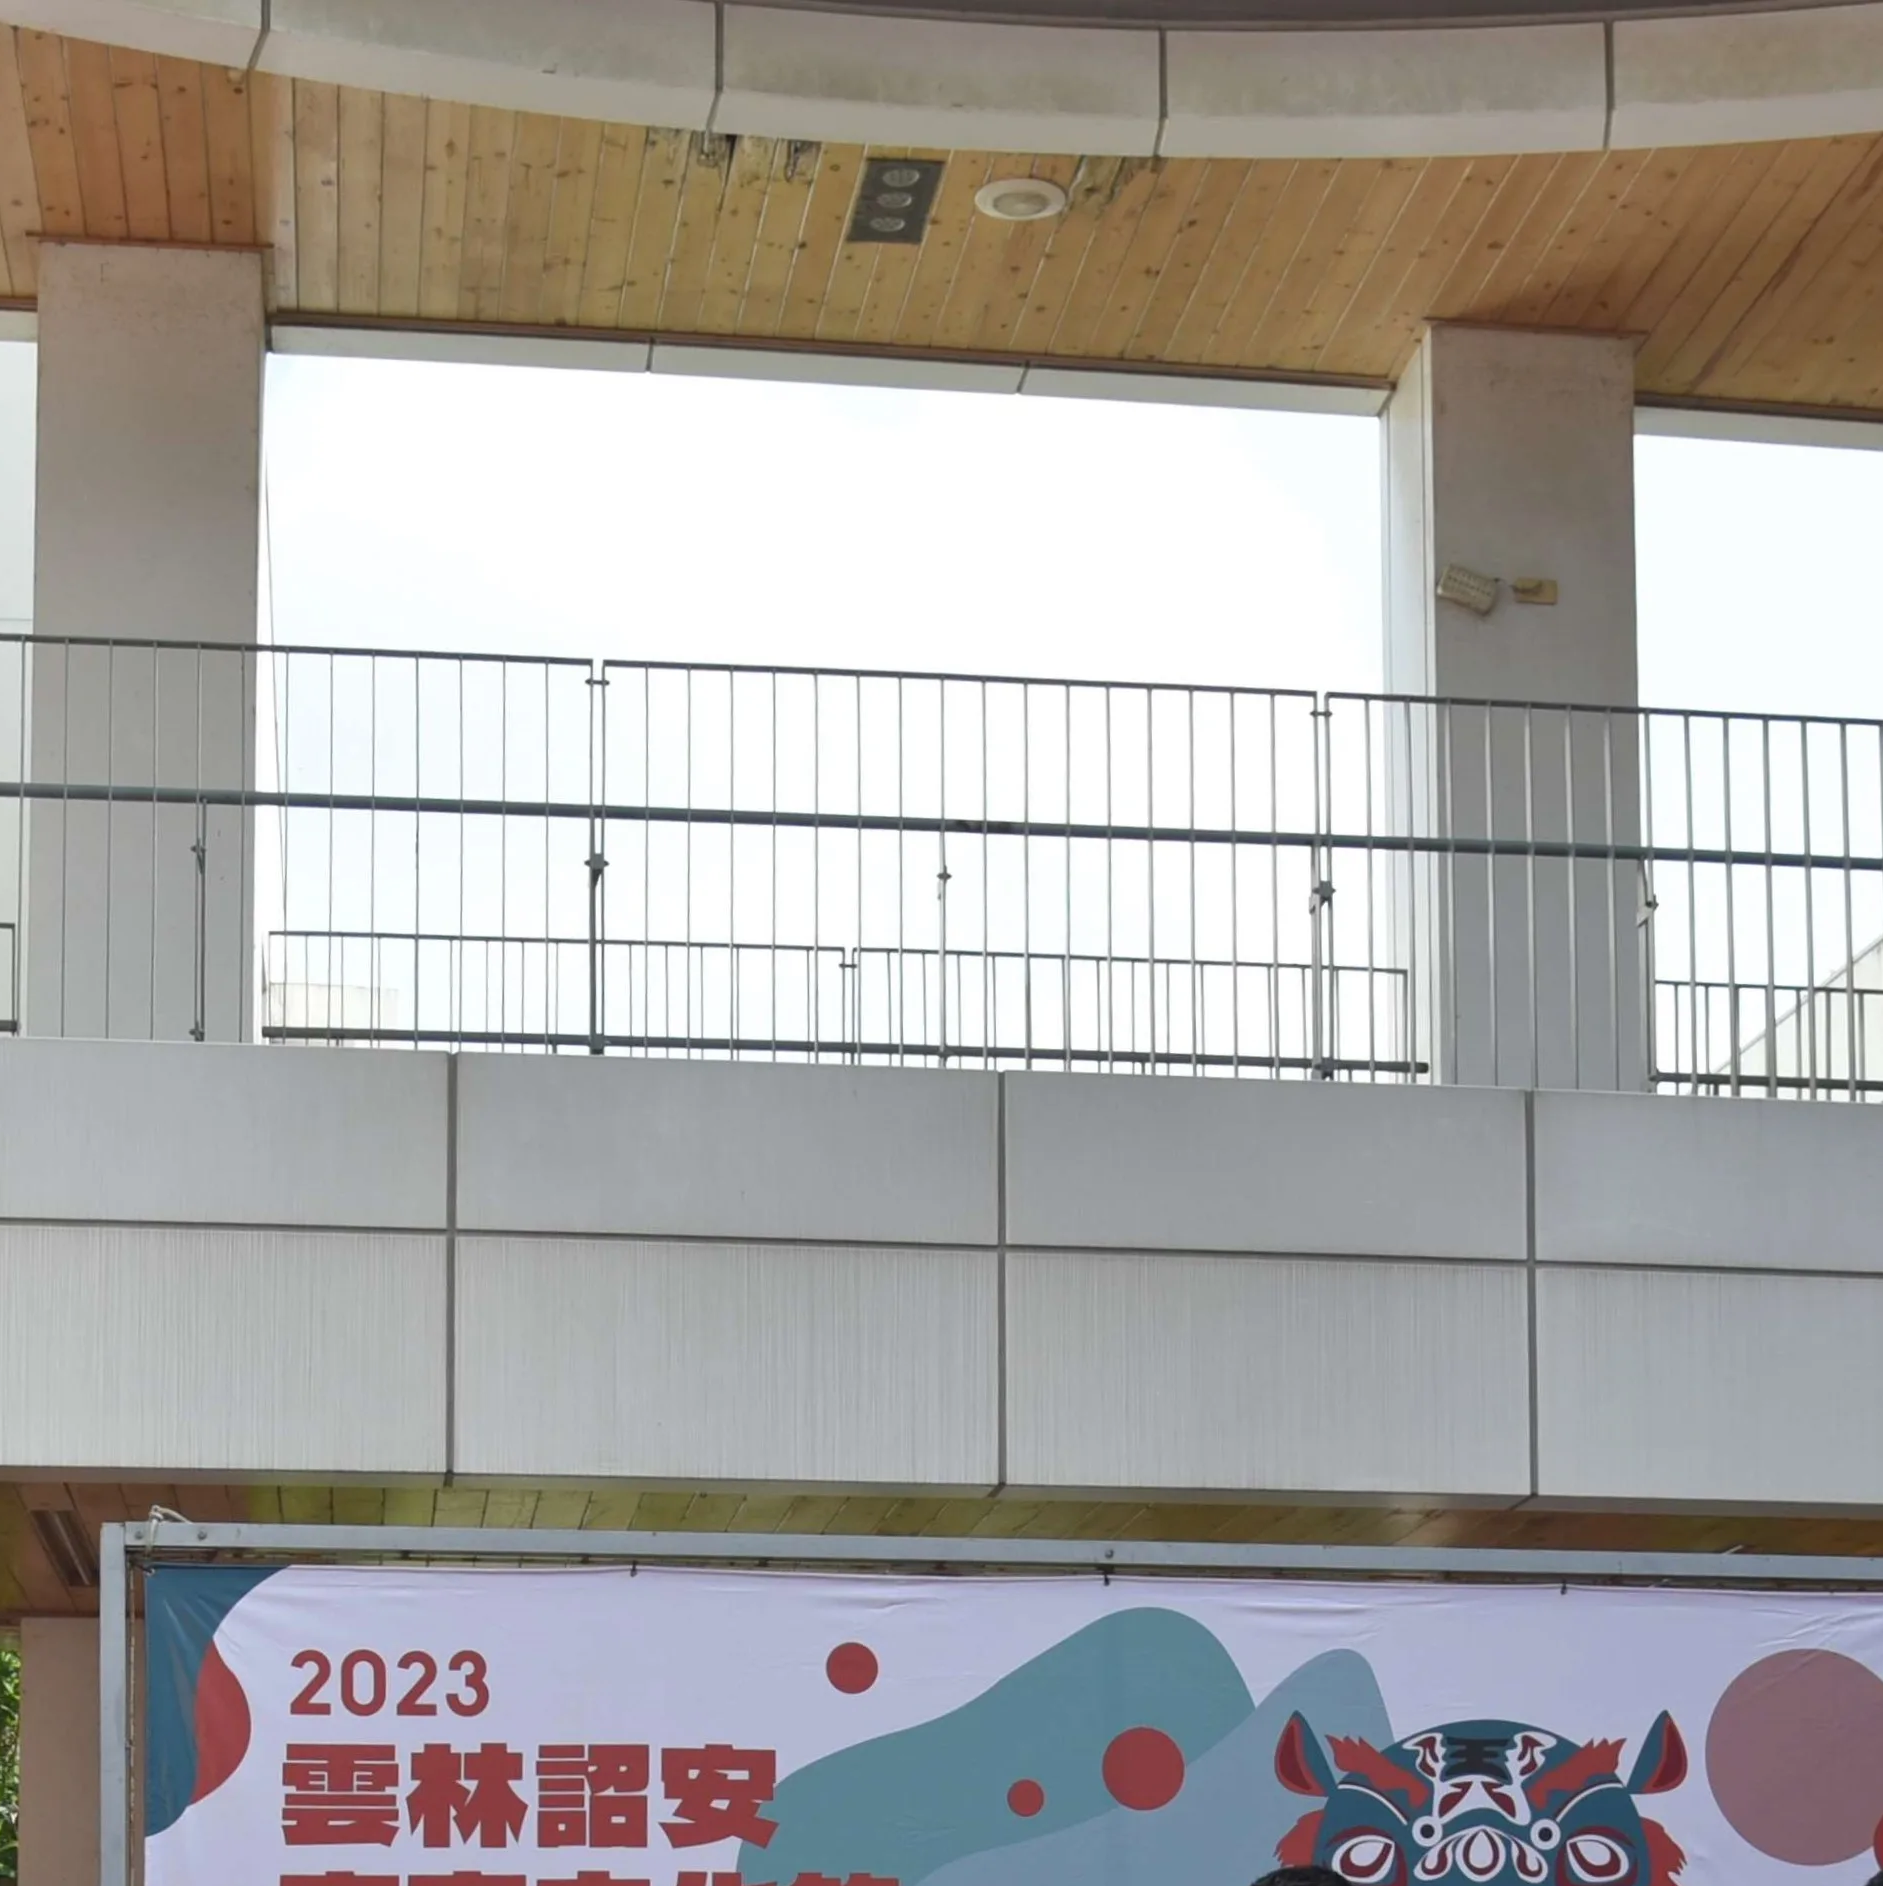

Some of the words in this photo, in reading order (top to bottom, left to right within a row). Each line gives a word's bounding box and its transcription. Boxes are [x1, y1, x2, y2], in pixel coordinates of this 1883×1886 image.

[290, 1649, 491, 1717] 2023
[282, 1742, 778, 1849] 雲林詔安
